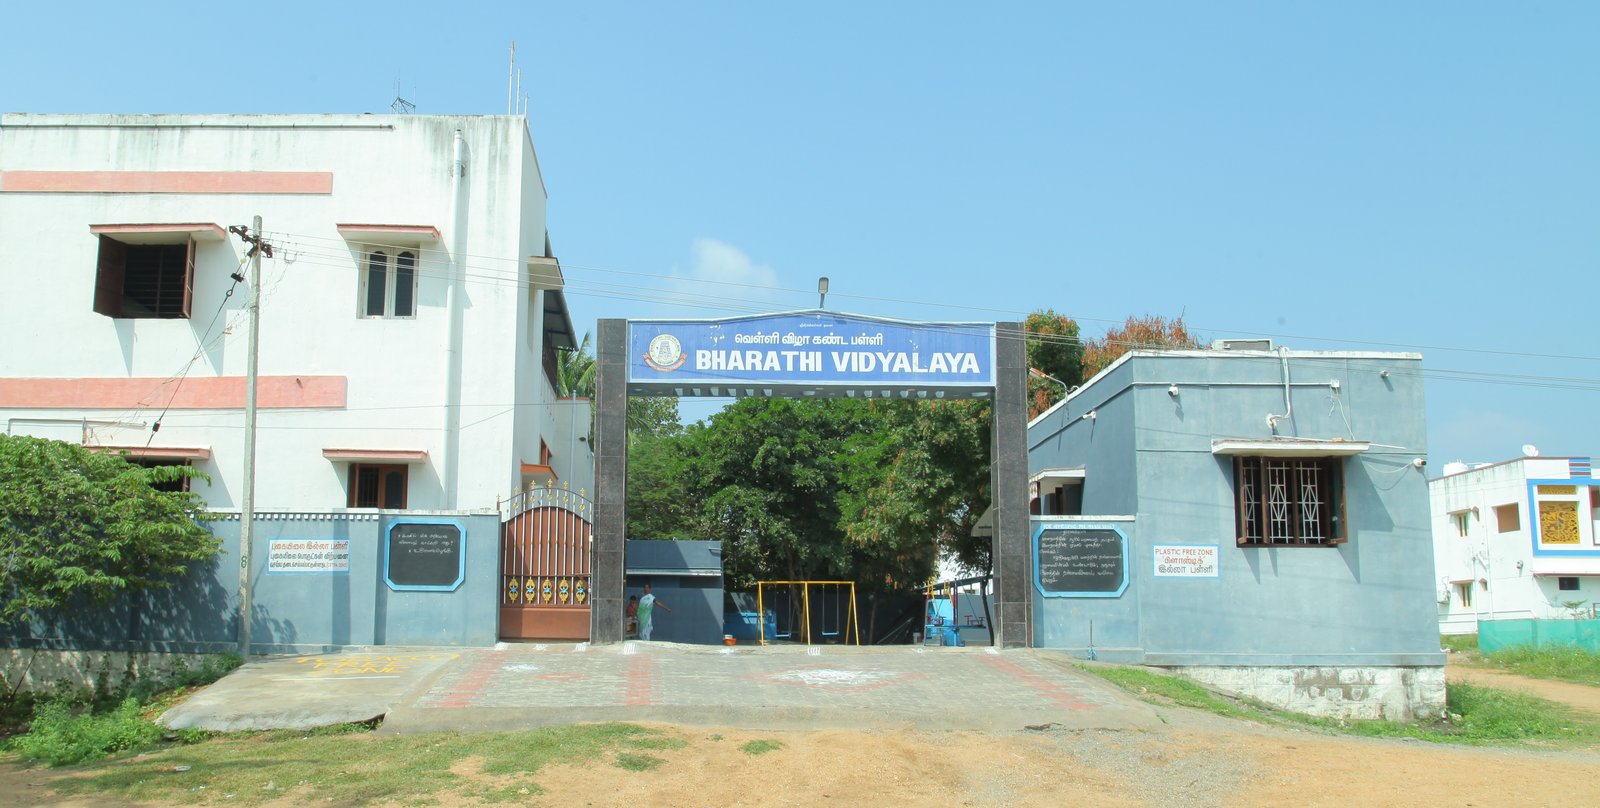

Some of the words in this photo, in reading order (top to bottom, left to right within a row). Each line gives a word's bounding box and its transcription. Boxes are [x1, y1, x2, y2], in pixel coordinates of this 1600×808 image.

[735, 331, 780, 345] வெள்ளி
[782, 331, 810, 347] விழா
[812, 331, 849, 346] கண்ட
[851, 332, 884, 346] பள்ளி
[696, 349, 822, 371] BHARATHI
[831, 351, 981, 374] VIDYALAYA
[1182, 548, 1197, 556] FREE
[1158, 564, 1187, 574] இல்லா
[1190, 564, 1214, 574] பள்ளி
